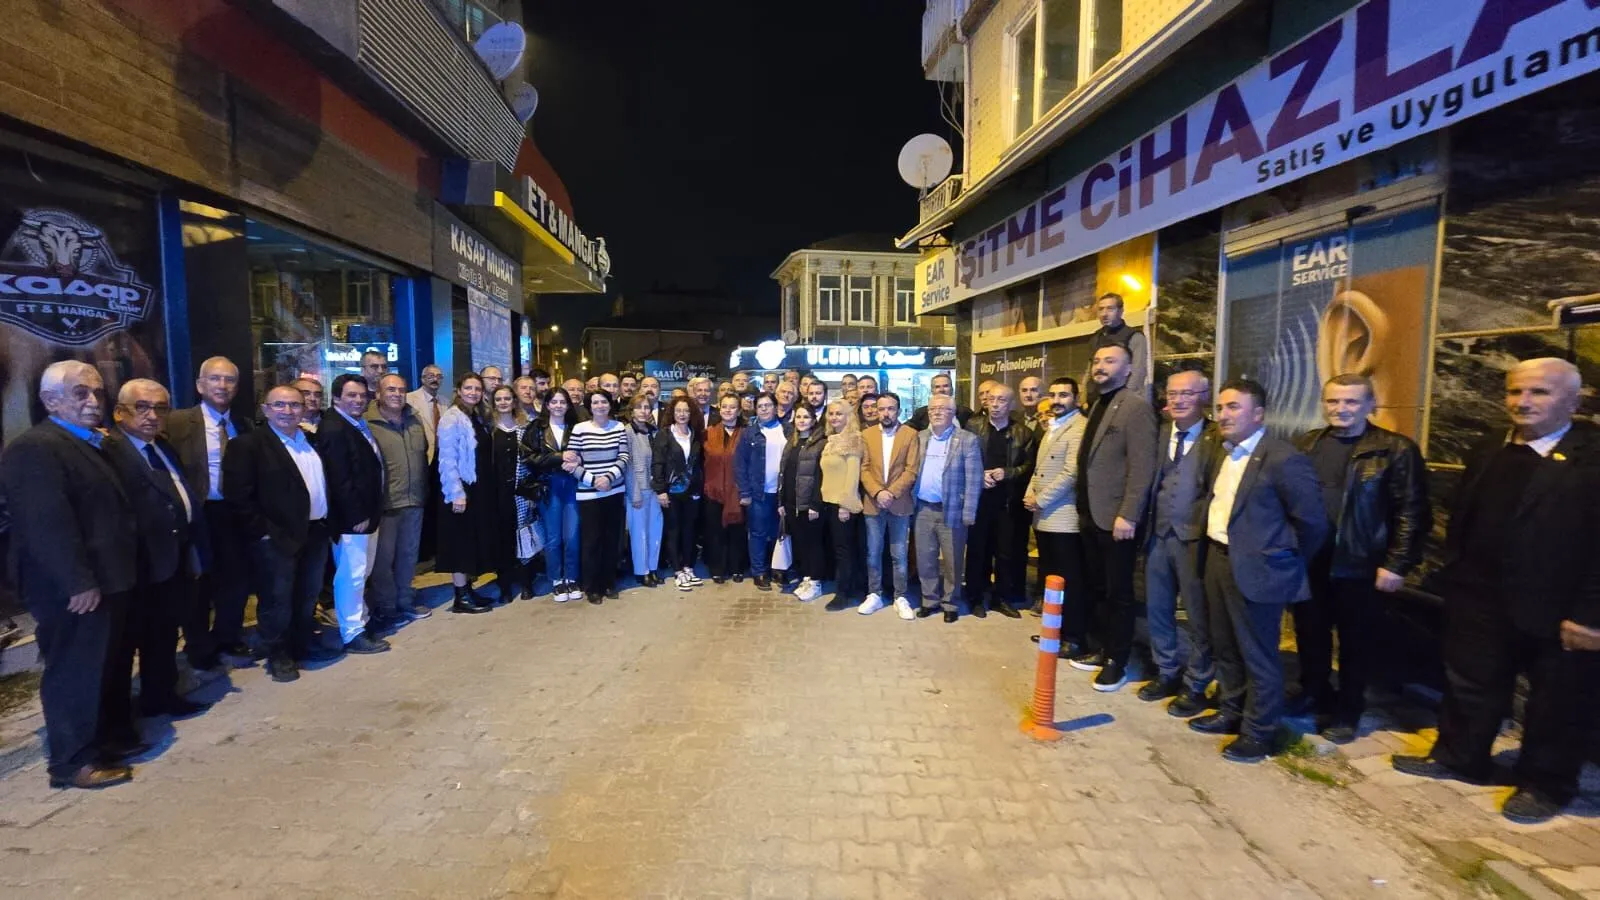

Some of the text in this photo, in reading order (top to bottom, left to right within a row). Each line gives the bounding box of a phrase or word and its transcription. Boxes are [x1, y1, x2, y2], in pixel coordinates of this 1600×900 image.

[1256, 141, 1325, 184] Satış
[1337, 121, 1374, 151] ve
[527, 175, 598, 272] ET & MANGAL
[450, 223, 486, 268] KASAP
[486, 248, 515, 287] MURAT
[926, 257, 946, 286] EAR
[1292, 236, 1349, 272] EAR
[16, 304, 110, 321] ET & MANGAL
[921, 282, 951, 309] Service
